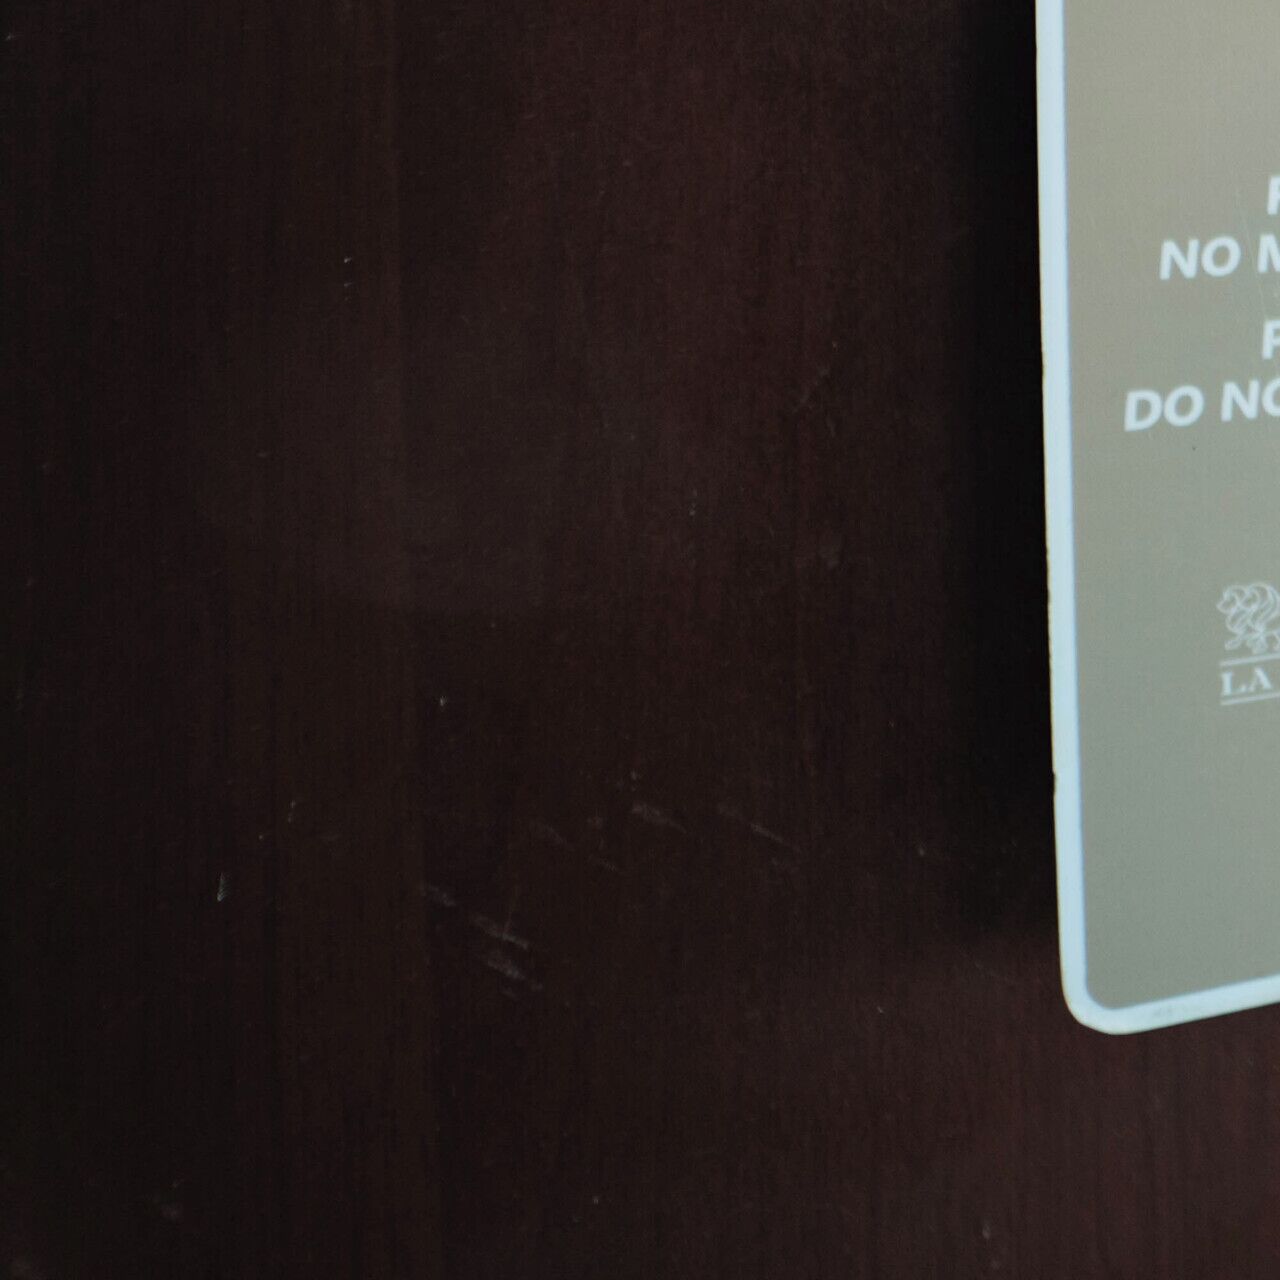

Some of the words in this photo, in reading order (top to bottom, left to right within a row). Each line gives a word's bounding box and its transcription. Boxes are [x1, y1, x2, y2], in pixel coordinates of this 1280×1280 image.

[1159, 236, 1241, 280] NO
[1123, 385, 1204, 432] DO
[1220, 668, 1272, 696] LA
